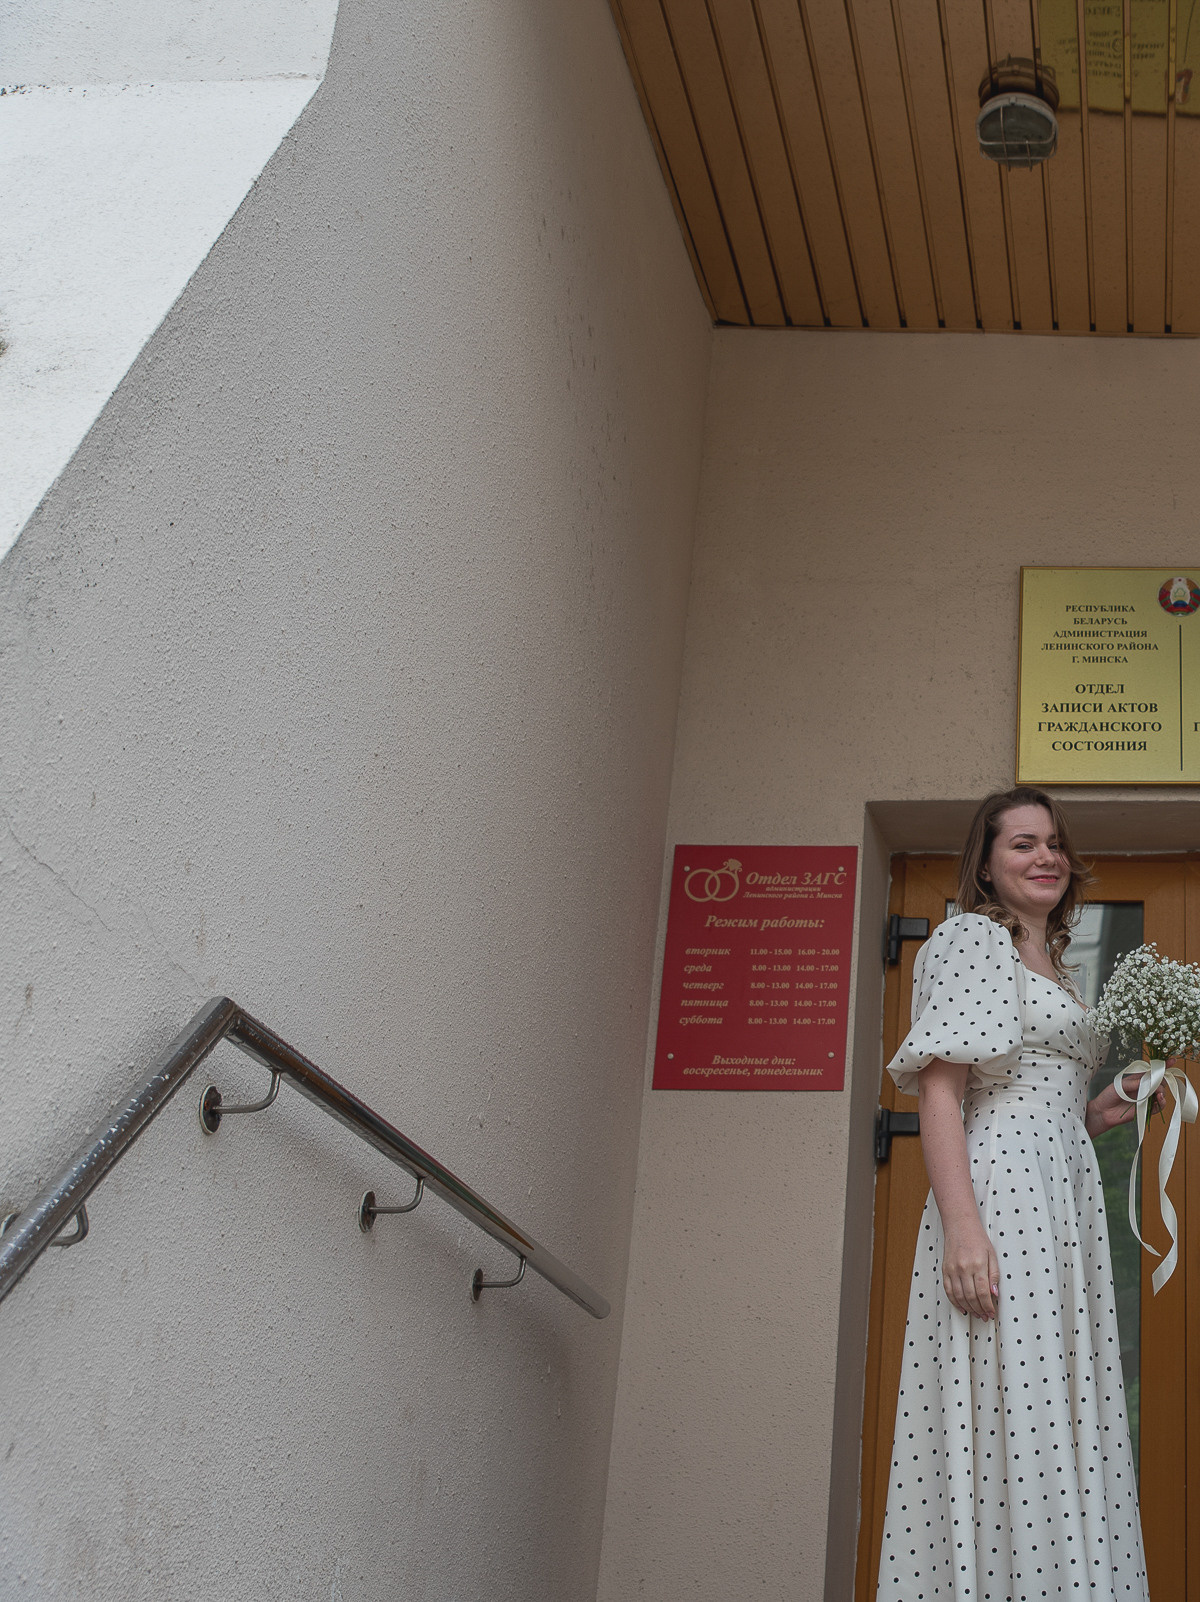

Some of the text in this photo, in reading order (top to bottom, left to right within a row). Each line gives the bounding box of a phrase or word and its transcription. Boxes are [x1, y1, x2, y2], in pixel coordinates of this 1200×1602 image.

[1065, 605, 1136, 613] РЕСПУБЛИКА
[1073, 617, 1128, 626] БЕЛАРУСЬ
[1053, 630, 1148, 639] АДМИНИСТРАЦИЯ
[1041, 641, 1159, 651] ЛЕНИНСКОГО РАЙОНА
[1072, 656, 1129, 664] Г. МИНСКА
[1075, 683, 1125, 696] ОТДЕЛ
[1041, 702, 1158, 713] ЗАПИСИ АКТОВ
[1038, 721, 1162, 733] ГРАЖДАНСКОГО
[1051, 741, 1147, 751] СОСТОЯНИЯ
[746, 872, 847, 885] Отдел ЗАГС
[704, 915, 825, 931] Режим работы:
[685, 947, 731, 956] вторник
[750, 948, 768, 956] 11.00
[774, 948, 792, 956] 15.00
[797, 948, 816, 956] 16.00
[821, 948, 840, 956] 20.00
[684, 963, 712, 973] среда
[683, 982, 724, 991] четверг
[680, 1000, 728, 1008] пятница
[679, 1015, 723, 1025] суббота
[748, 1017, 763, 1025] 8.00
[769, 1017, 787, 1025] 13.00
[793, 1017, 811, 1025] 14.00
[817, 1017, 836, 1025] 17.00
[712, 1055, 796, 1067] Выходные дни:
[683, 1067, 823, 1076] воскресенье, понедельник
